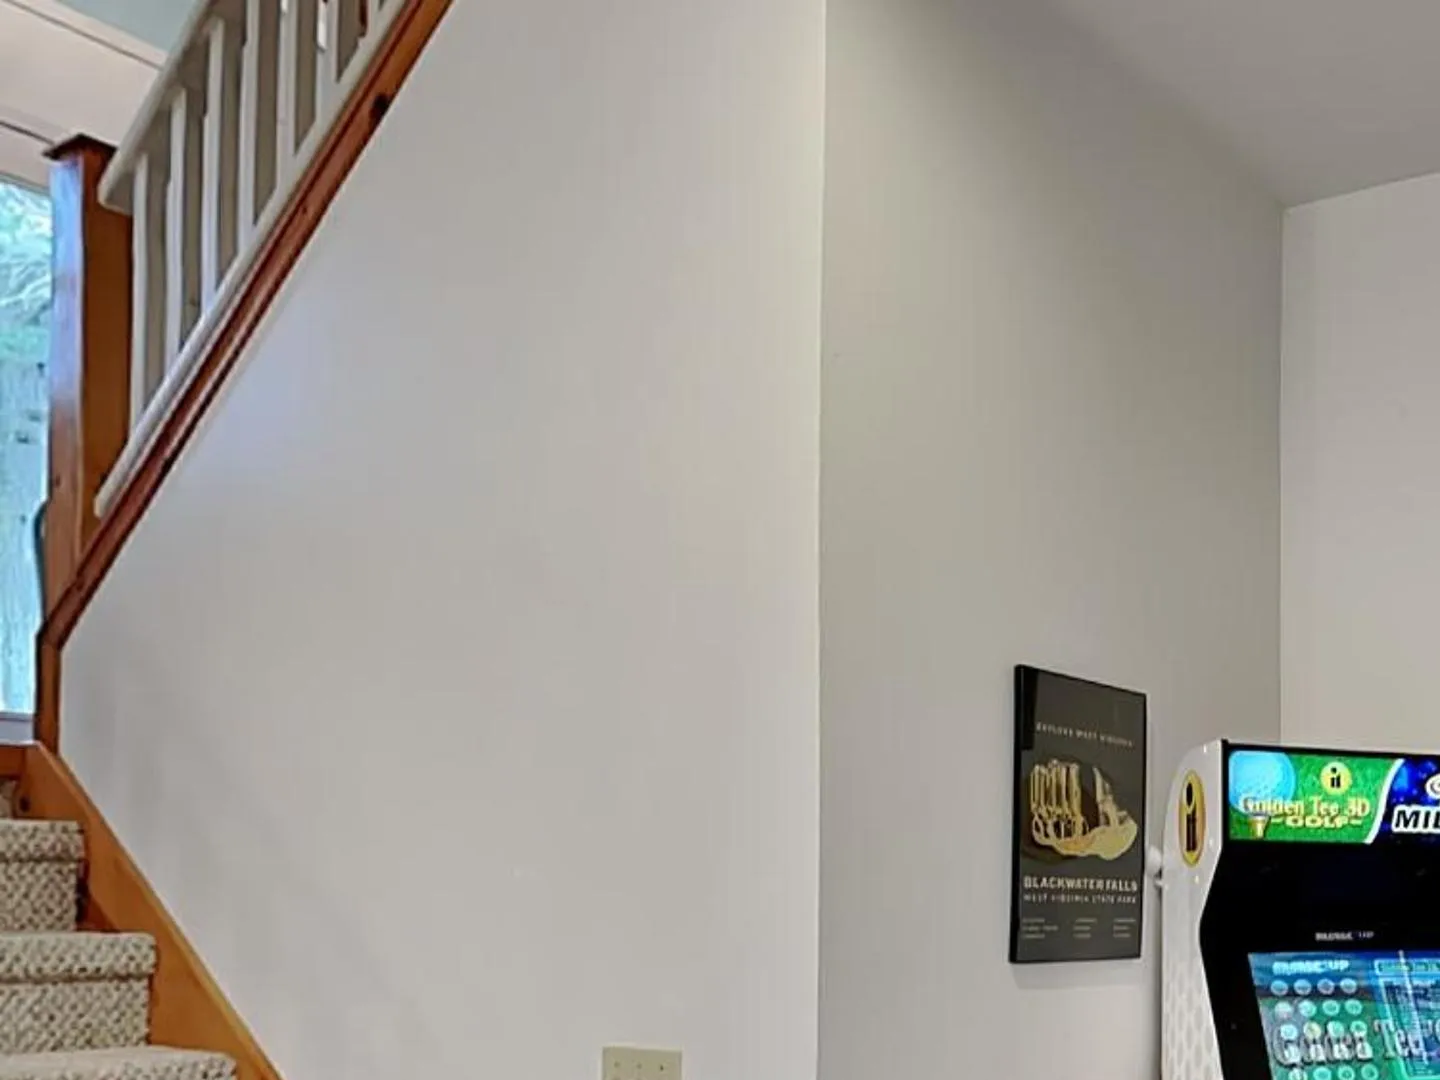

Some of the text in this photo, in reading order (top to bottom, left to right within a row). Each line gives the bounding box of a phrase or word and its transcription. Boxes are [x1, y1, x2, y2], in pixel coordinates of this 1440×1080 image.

[1311, 795, 1339, 818] Tee
[1285, 815, 1349, 829] GOLF
[1023, 875, 1138, 892] BLACKWATER FALLS
